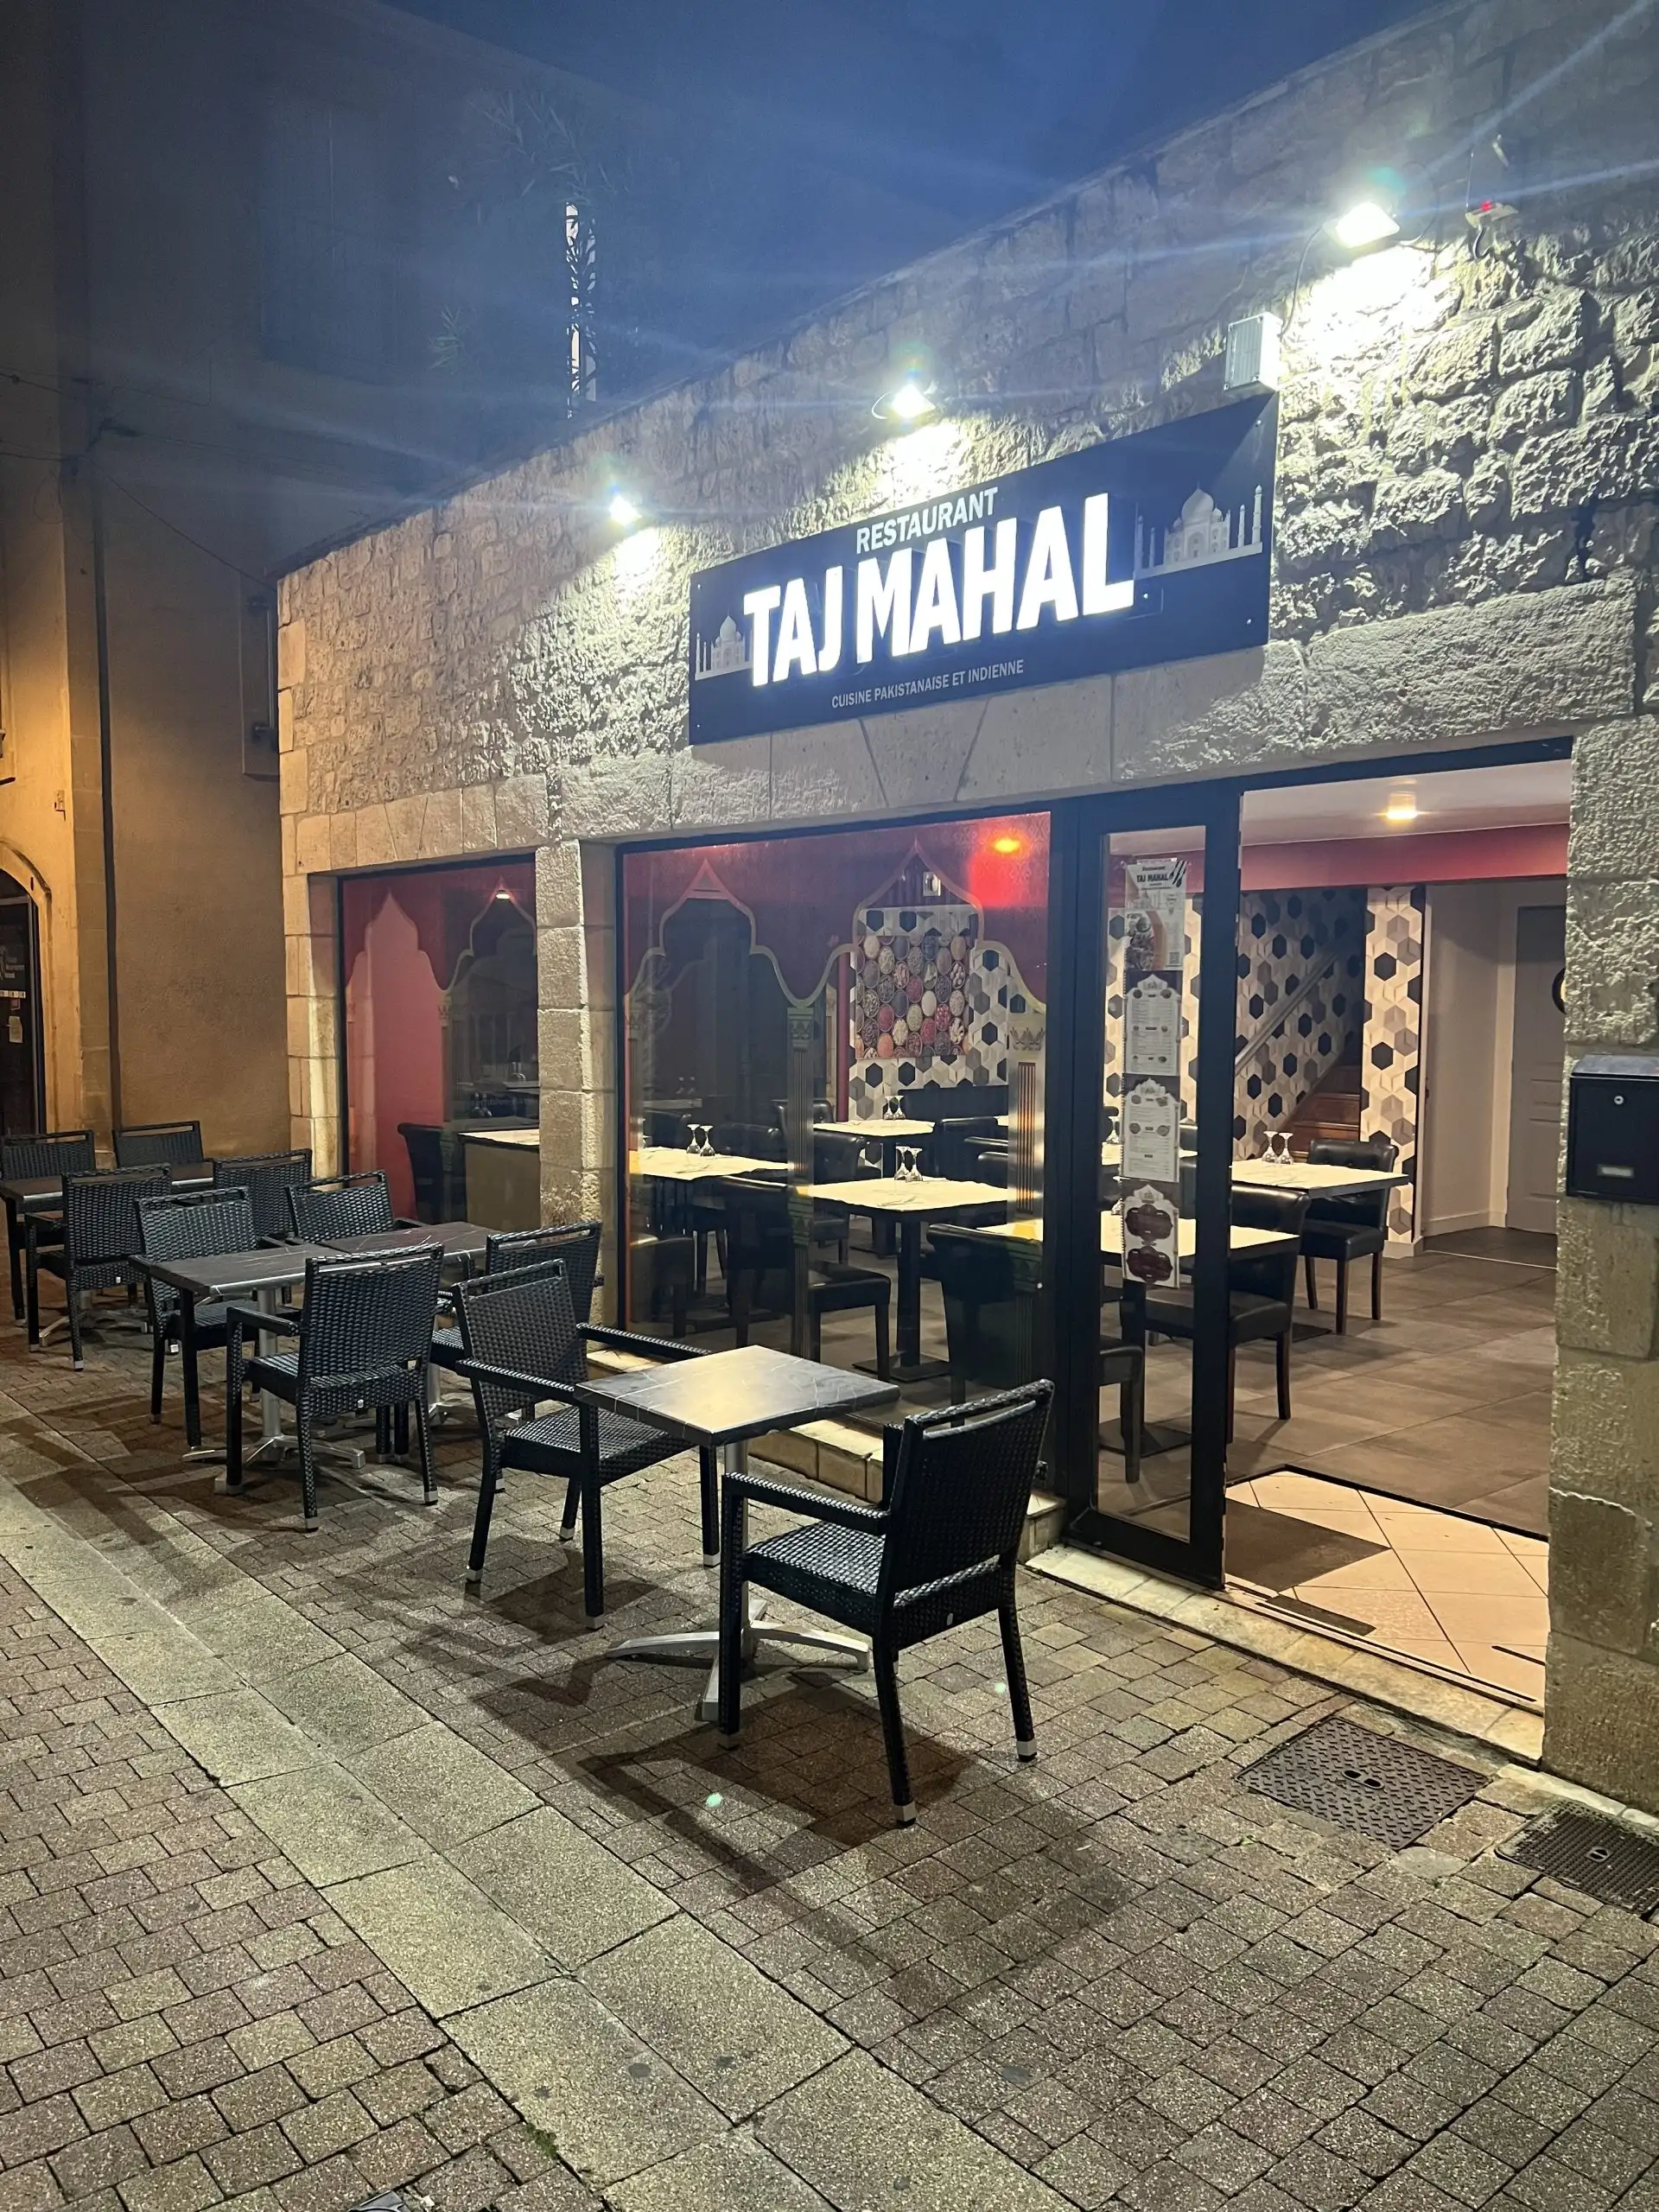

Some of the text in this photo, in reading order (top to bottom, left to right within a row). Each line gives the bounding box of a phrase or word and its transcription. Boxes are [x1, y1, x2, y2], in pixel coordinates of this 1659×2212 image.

[856, 486, 998, 554] RESTAURANT
[744, 493, 1134, 686] TAJ MAHAL
[832, 659, 1024, 709] CUISINE PAKISTANAISE ET INDIENNE
